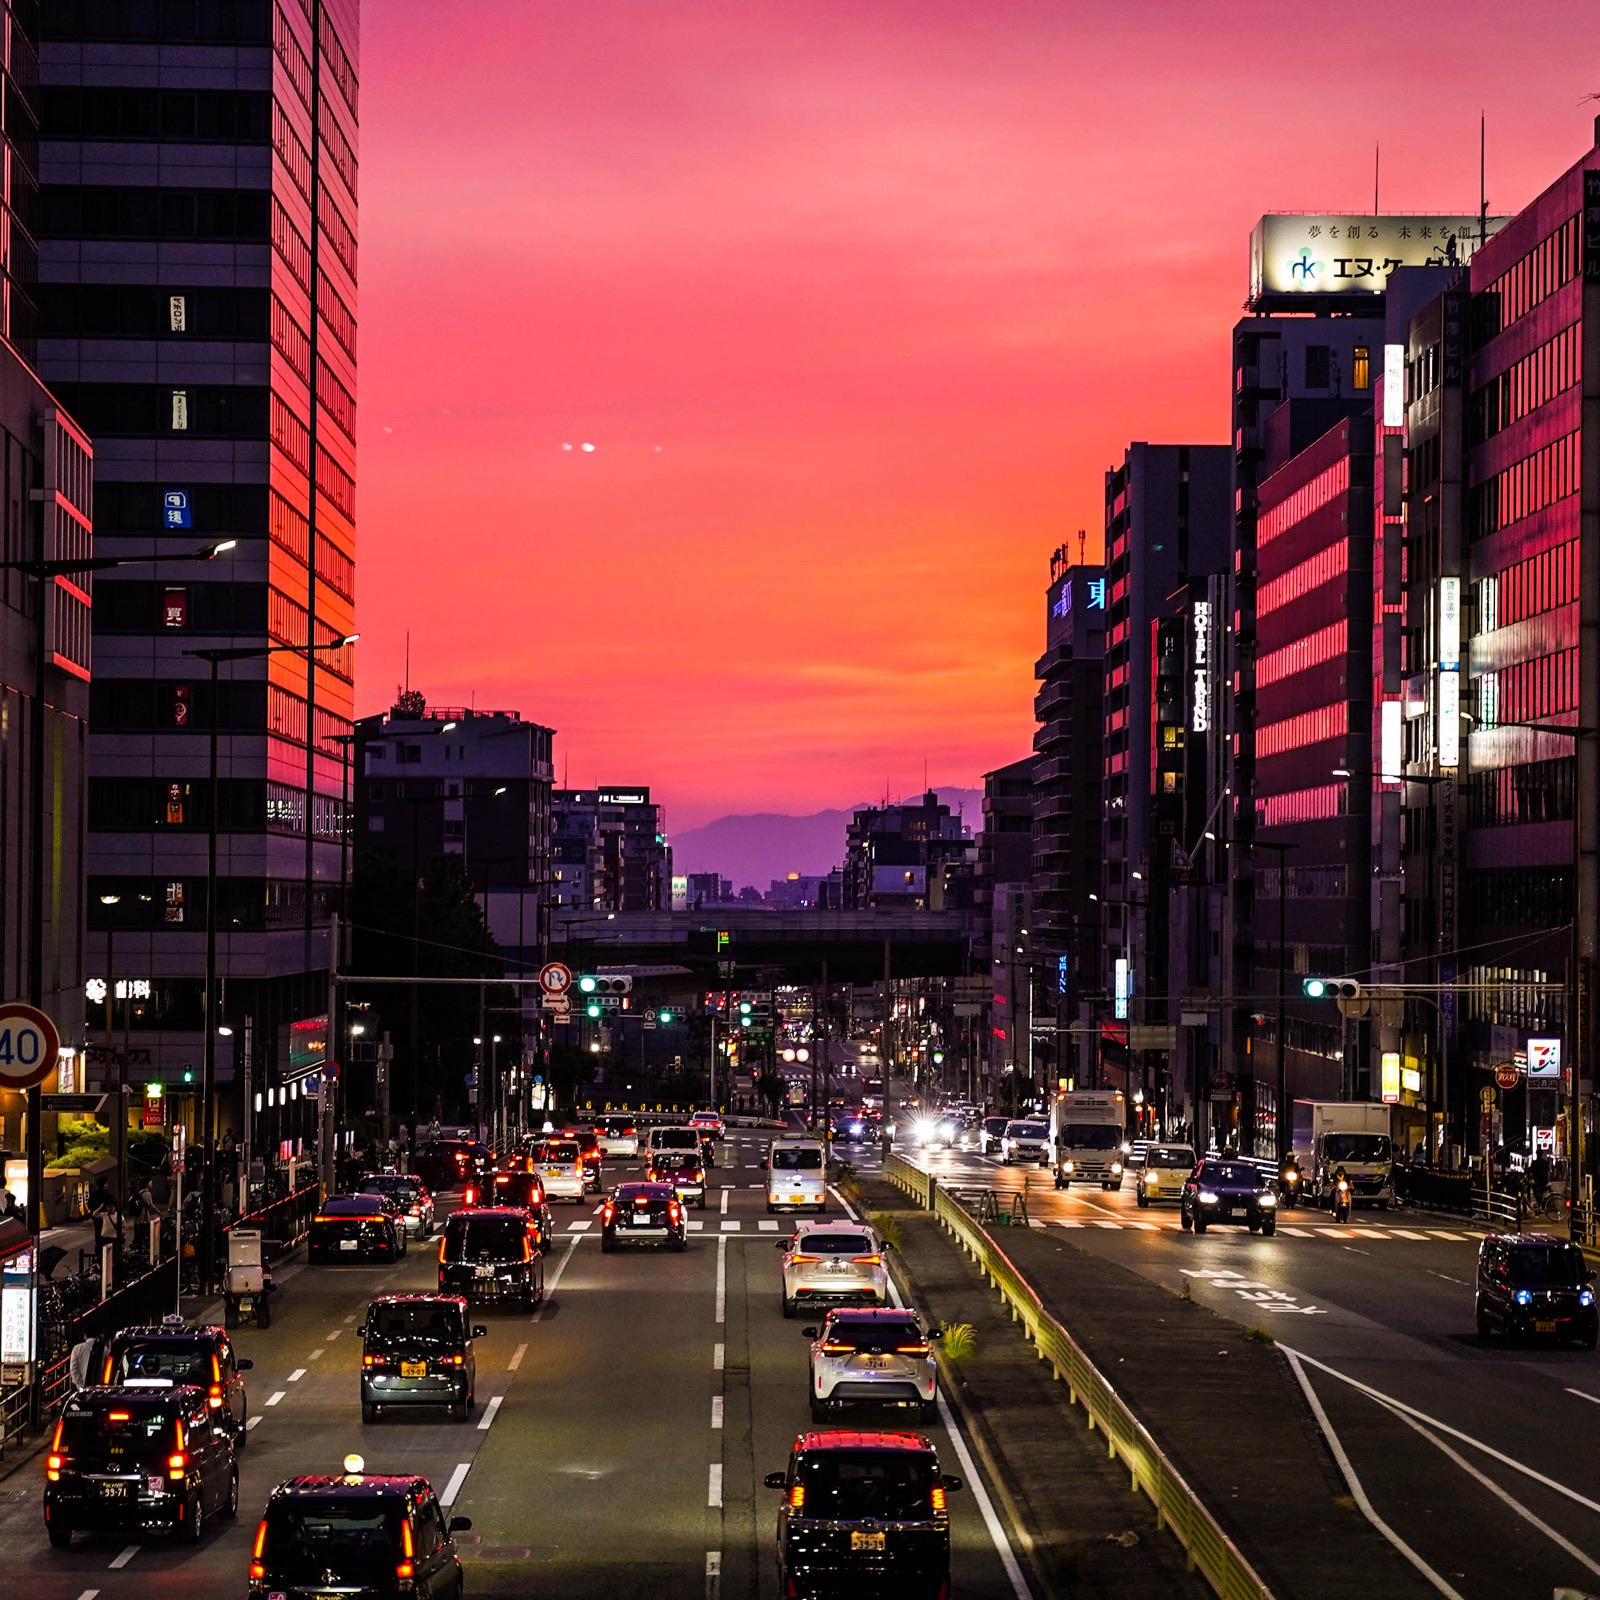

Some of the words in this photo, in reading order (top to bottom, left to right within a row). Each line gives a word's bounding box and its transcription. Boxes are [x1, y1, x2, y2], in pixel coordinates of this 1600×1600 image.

[1308, 225, 1379, 239] 夢を創る
[1194, 601, 1208, 664] HOTEL
[1193, 669, 1208, 732] TREND
[0, 1028, 39, 1065] 40
[105, 1488, 127, 1497] 99-71
